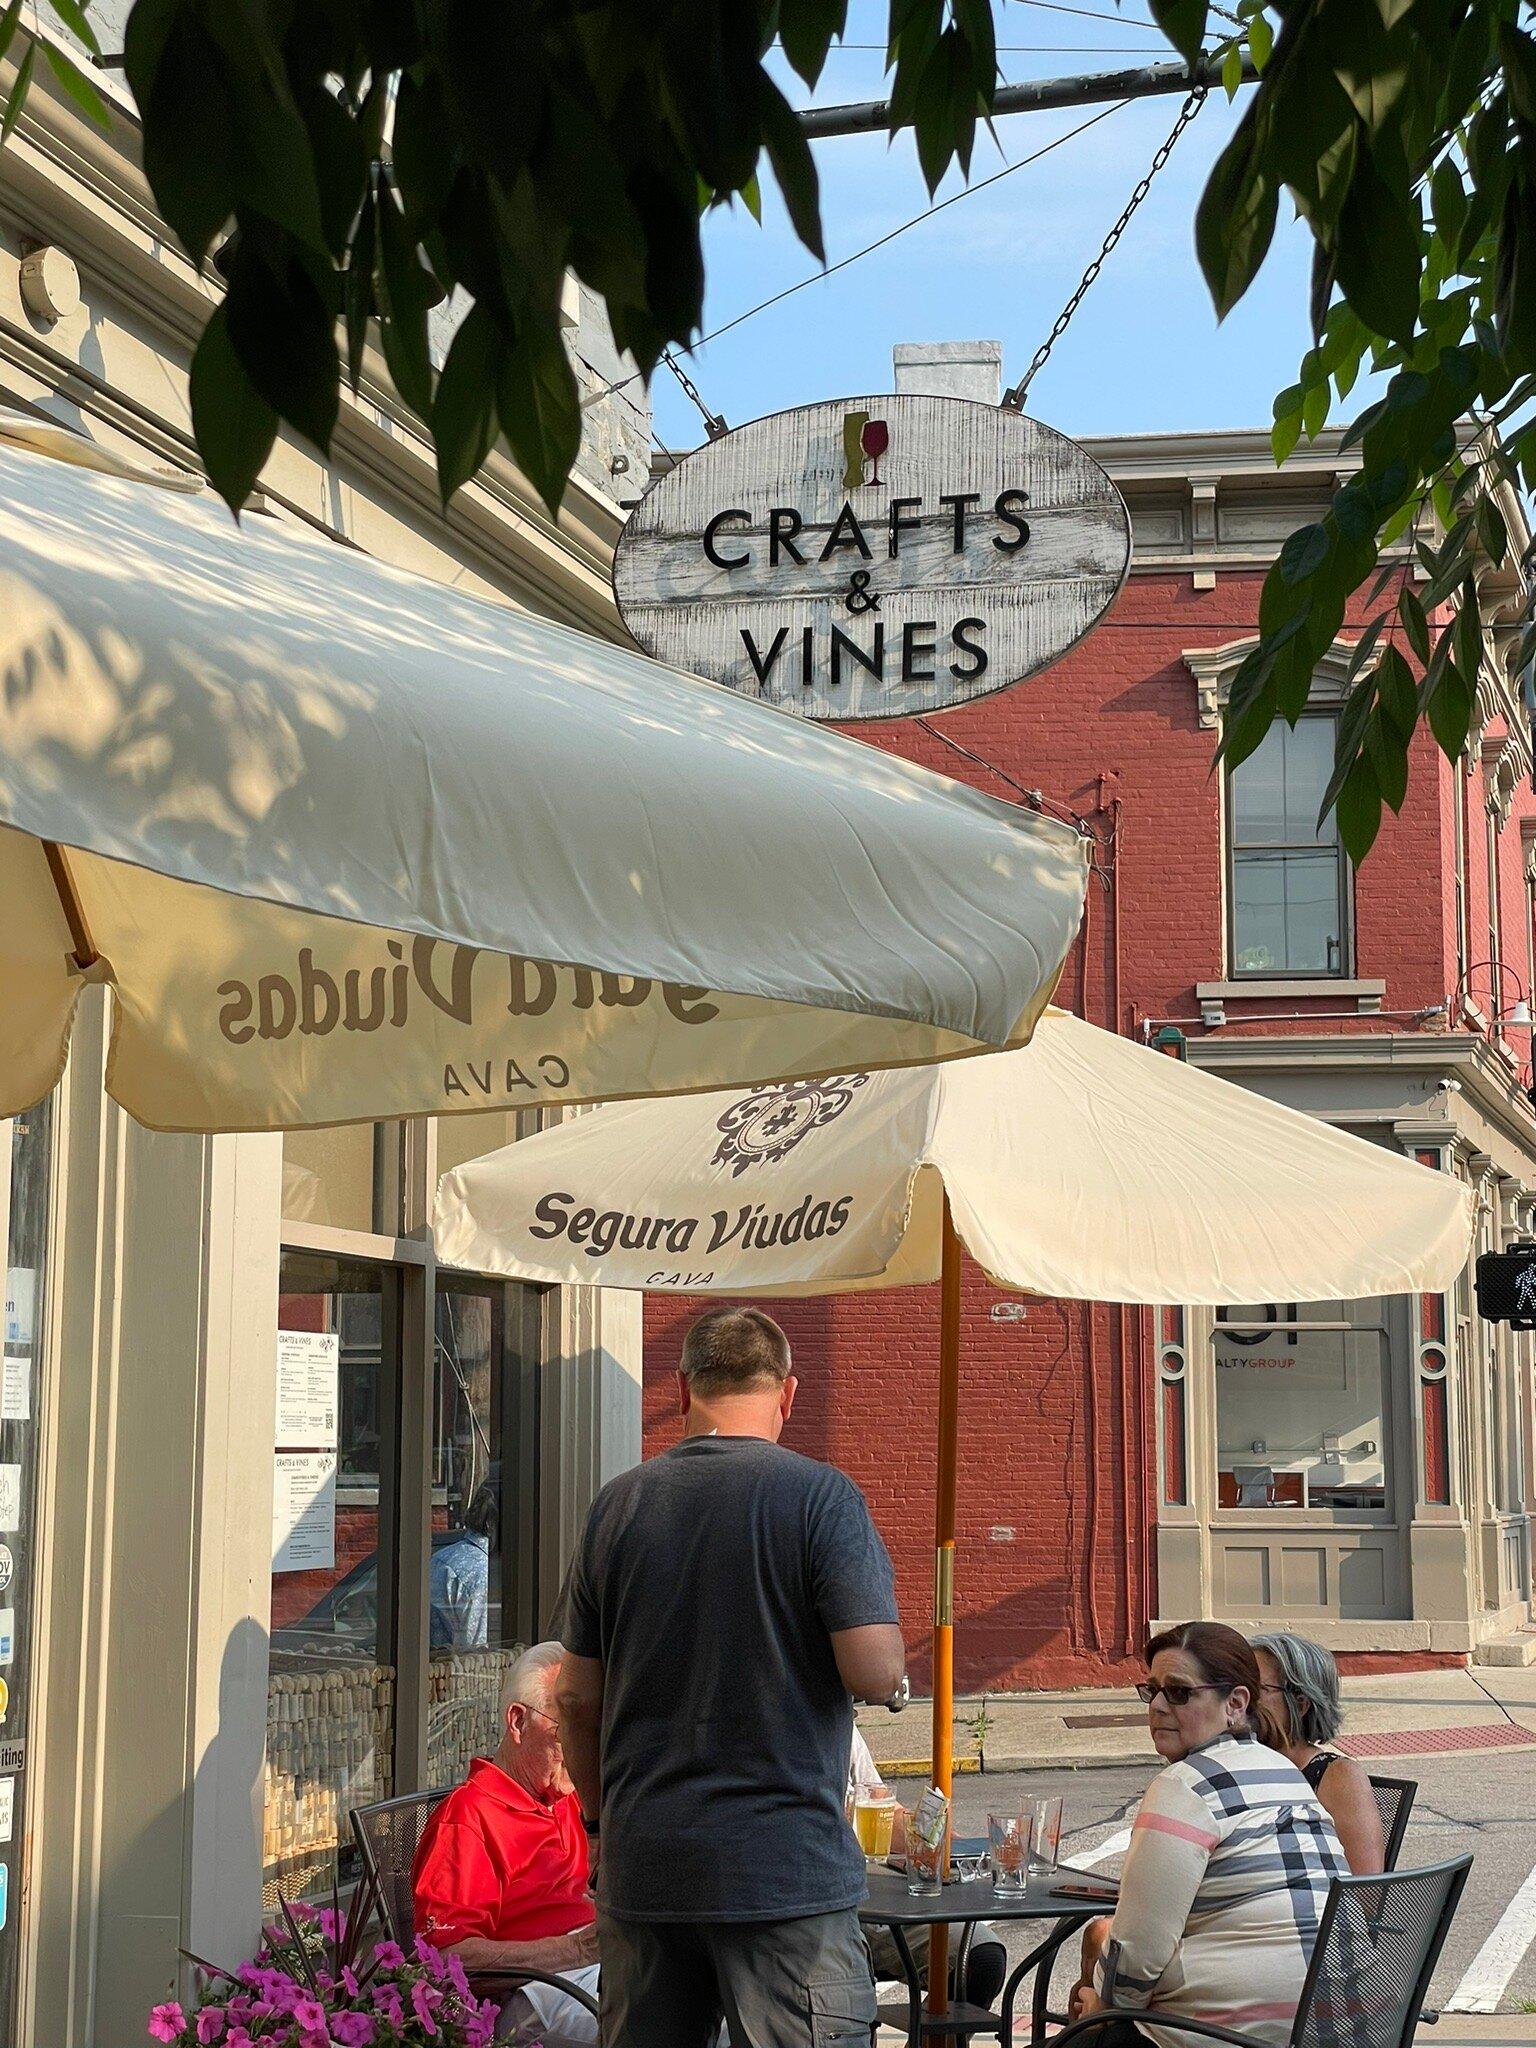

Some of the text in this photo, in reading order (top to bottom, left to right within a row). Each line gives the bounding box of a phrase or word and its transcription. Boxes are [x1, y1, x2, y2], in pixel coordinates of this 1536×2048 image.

[703, 489, 1030, 569] CRAFTS
[845, 570, 882, 614] &
[740, 617, 988, 687] VINES
[529, 1192, 854, 1257] Segura Viudas
[646, 1271, 715, 1286] CAVA
[1216, 1358, 1296, 1368] ALTYGROUP
[0, 1747, 24, 1769] iting
